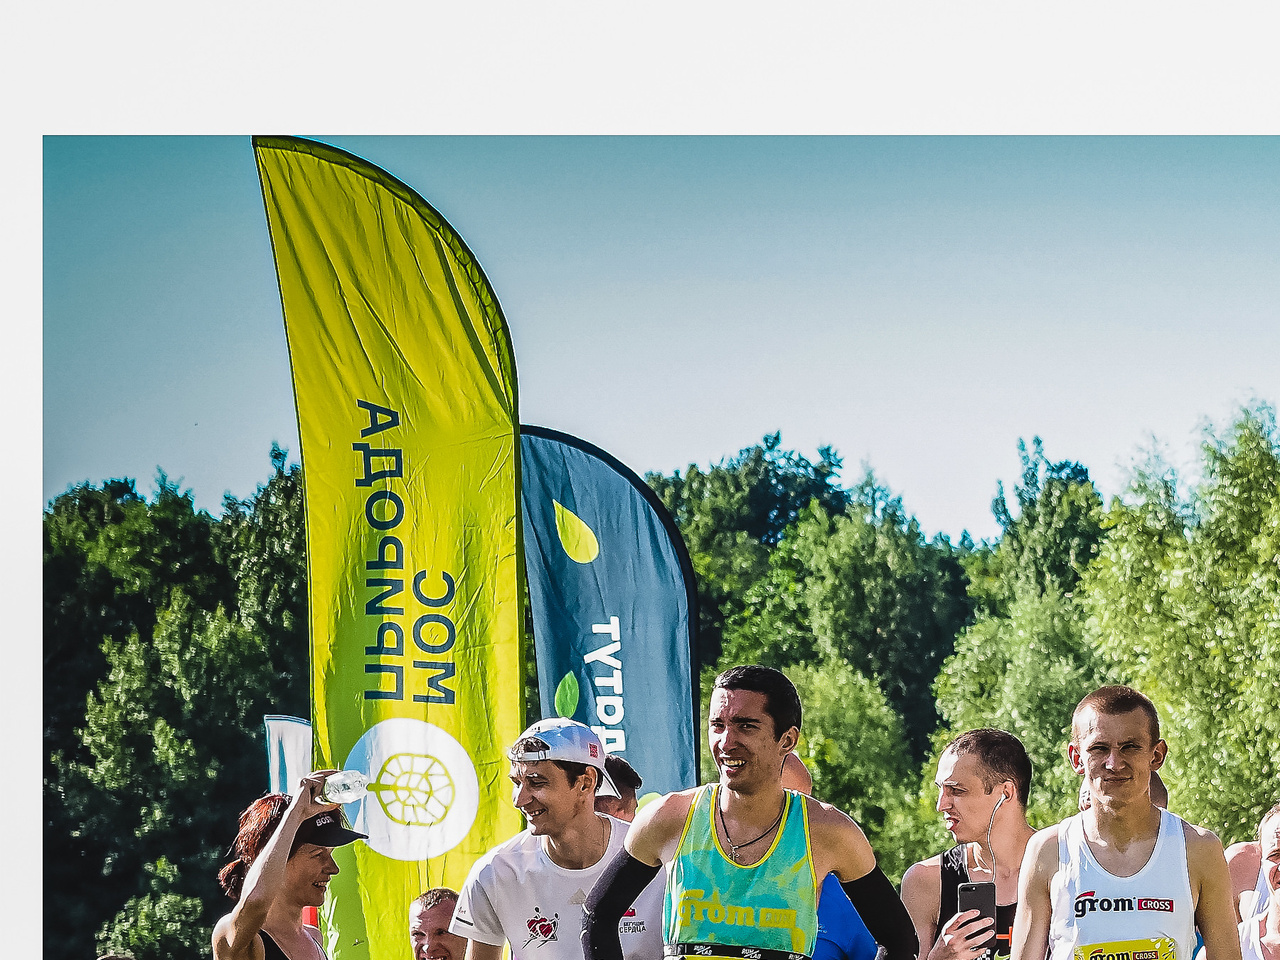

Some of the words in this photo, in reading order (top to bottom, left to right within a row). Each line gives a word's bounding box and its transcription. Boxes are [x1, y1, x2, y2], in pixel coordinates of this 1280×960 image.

[1074, 890, 1135, 918] grom
[1140, 899, 1171, 911] CROSS
[1134, 951, 1157, 960] CROSS
